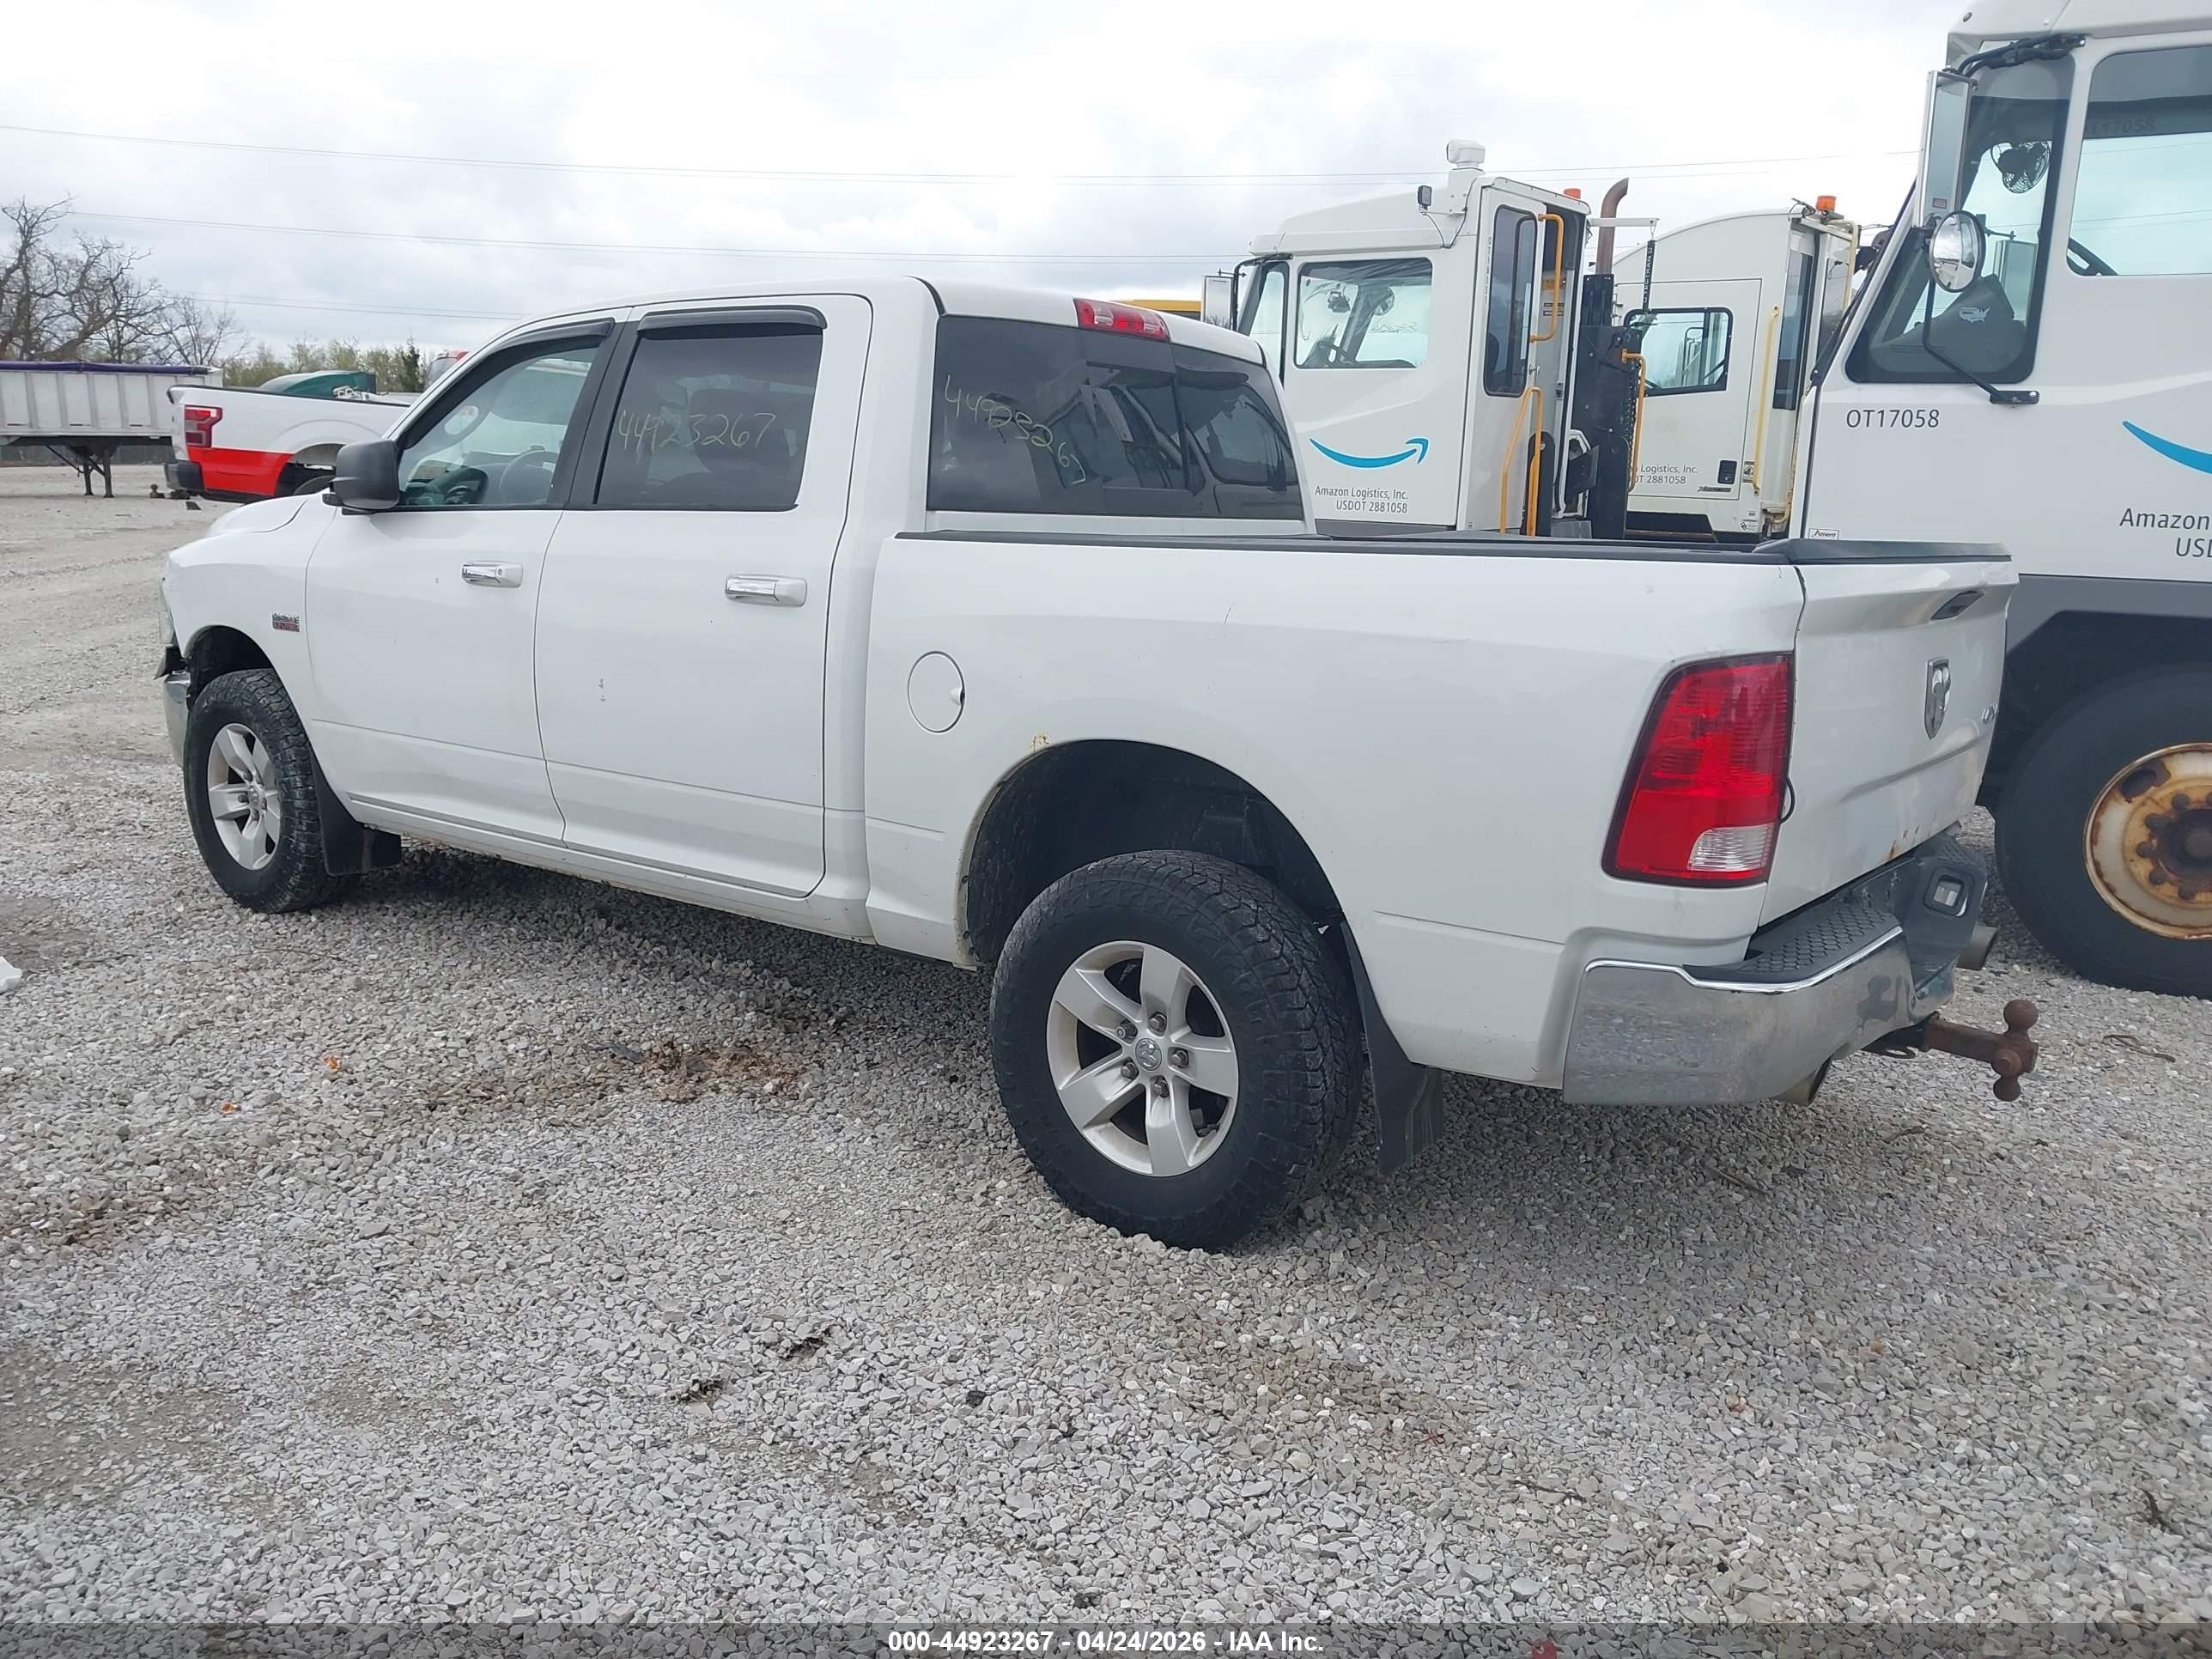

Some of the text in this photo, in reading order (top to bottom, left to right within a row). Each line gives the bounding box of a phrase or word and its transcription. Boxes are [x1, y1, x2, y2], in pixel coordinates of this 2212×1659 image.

[1846, 409, 1940, 428] OT17058
[618, 410, 776, 462] 44923267
[1641, 465, 1680, 474] Logistics,
[1647, 476, 1686, 484] 2881058
[1315, 485, 1408, 500] Amazon Logistics, Inc.
[1336, 500, 1407, 513] USDOT 2881058
[2119, 507, 2210, 530] Amazon
